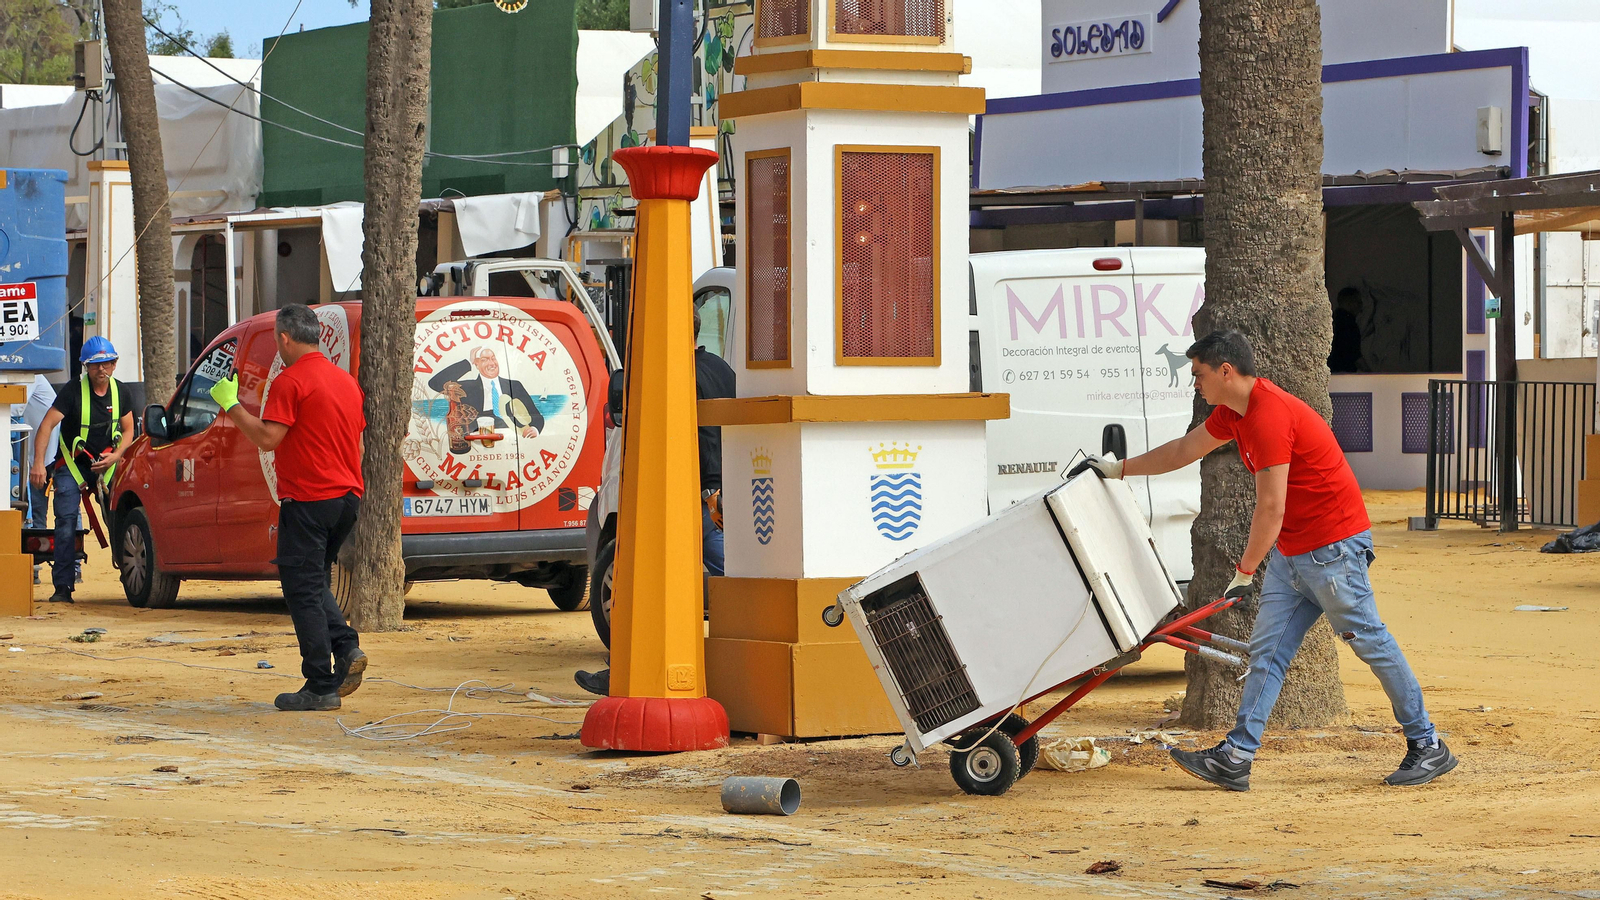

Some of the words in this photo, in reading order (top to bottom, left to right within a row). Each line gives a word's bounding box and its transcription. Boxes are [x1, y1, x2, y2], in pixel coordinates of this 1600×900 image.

[492, 309, 557, 355] EXQUISITA
[413, 321, 547, 374] VICTORIA
[1002, 345, 1053, 357] Decoración
[1056, 345, 1089, 358] Integral
[1091, 344, 1103, 355] de
[1105, 345, 1140, 355] eventos
[563, 368, 578, 396] 1928
[1019, 370, 1039, 381] 627
[1043, 370, 1055, 380] 21
[1060, 369, 1073, 380] 59
[1076, 369, 1090, 379] 54
[1100, 368, 1120, 378] 955
[1124, 368, 1136, 377] 11
[1155, 366, 1168, 376] 50
[1086, 389, 1195, 400] mirka.eventos@gmail.co
[571, 402, 581, 420] EN
[469, 454, 502, 462] DESDE
[530, 424, 580, 495] FRANQUELO
[416, 456, 459, 495] CREADA
[438, 449, 558, 491] MÁLAGA
[997, 461, 1058, 475] RENAULT
[414, 498, 453, 514] 6747
[459, 498, 489, 513] HYM
[496, 491, 527, 504] LUIS
